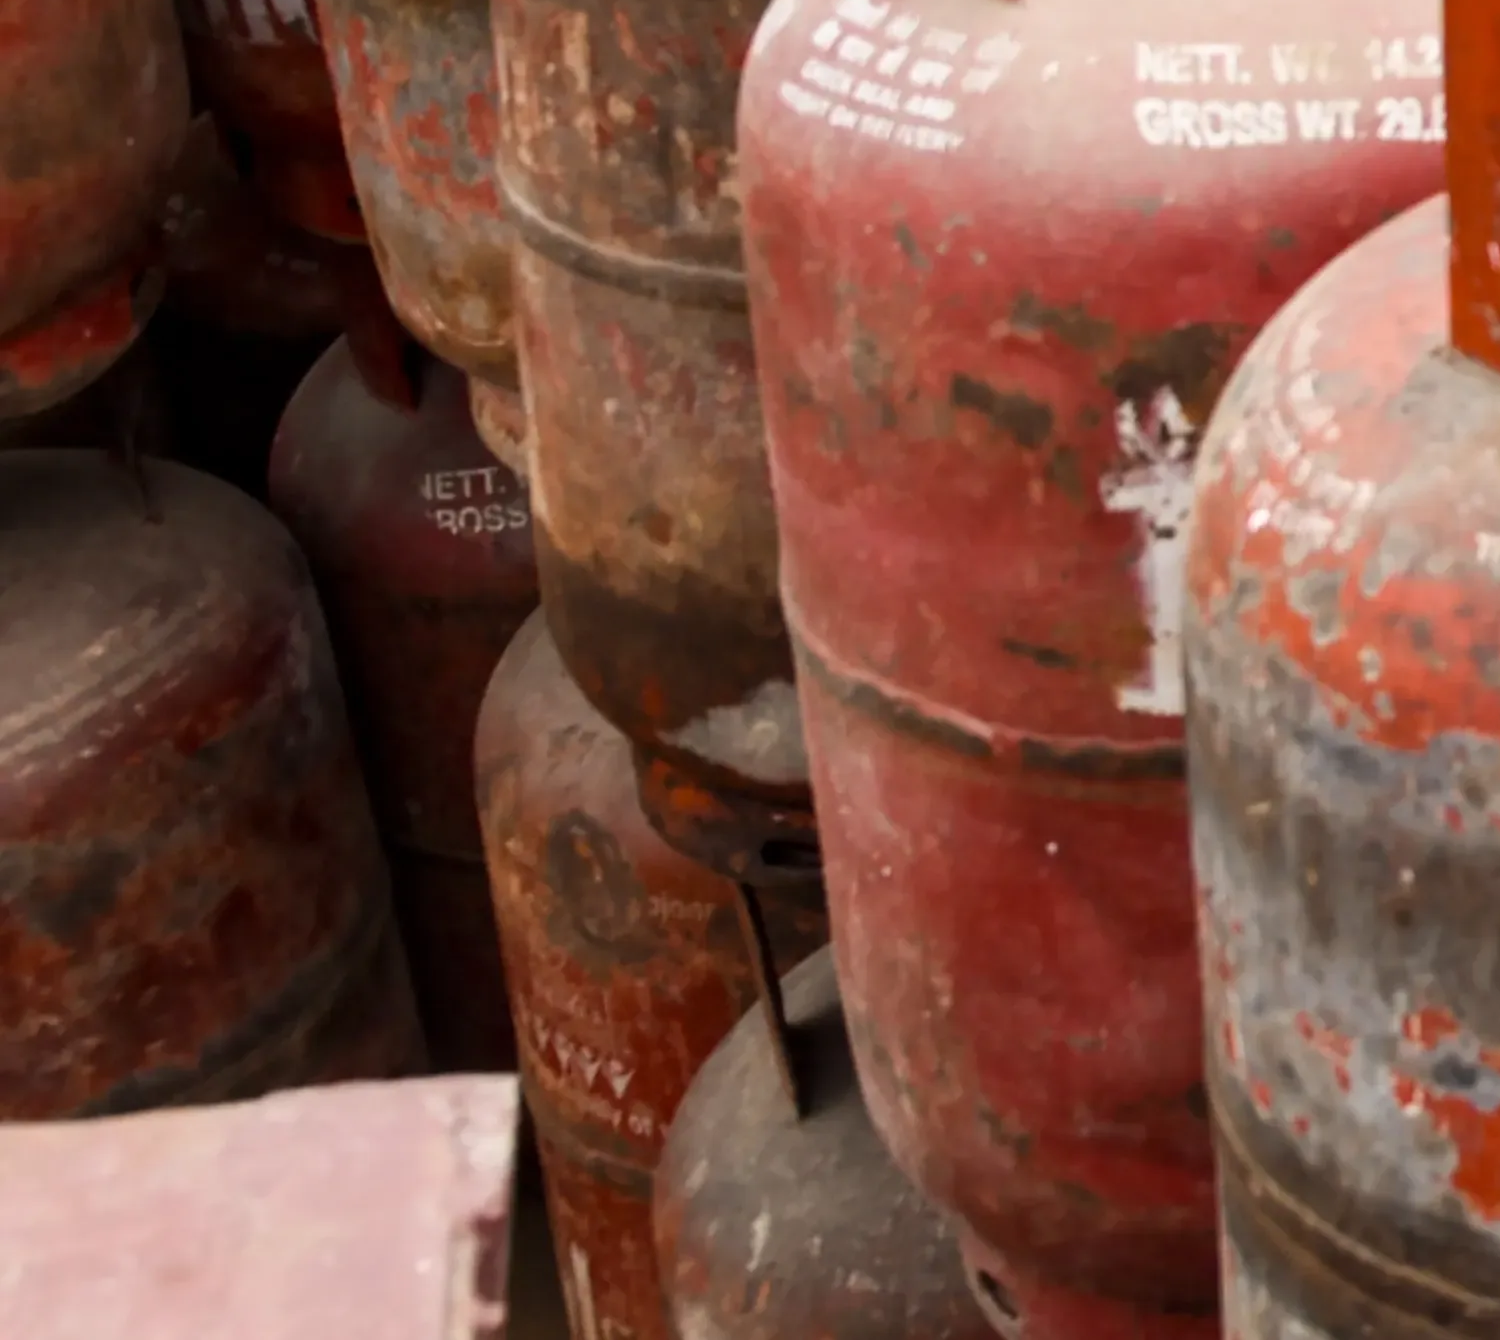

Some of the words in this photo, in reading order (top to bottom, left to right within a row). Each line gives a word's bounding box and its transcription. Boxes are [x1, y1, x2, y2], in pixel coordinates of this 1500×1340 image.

[1133, 97, 1288, 148] GROSS
[1295, 99, 1367, 144] WT.
[436, 502, 528, 537] ROSS
